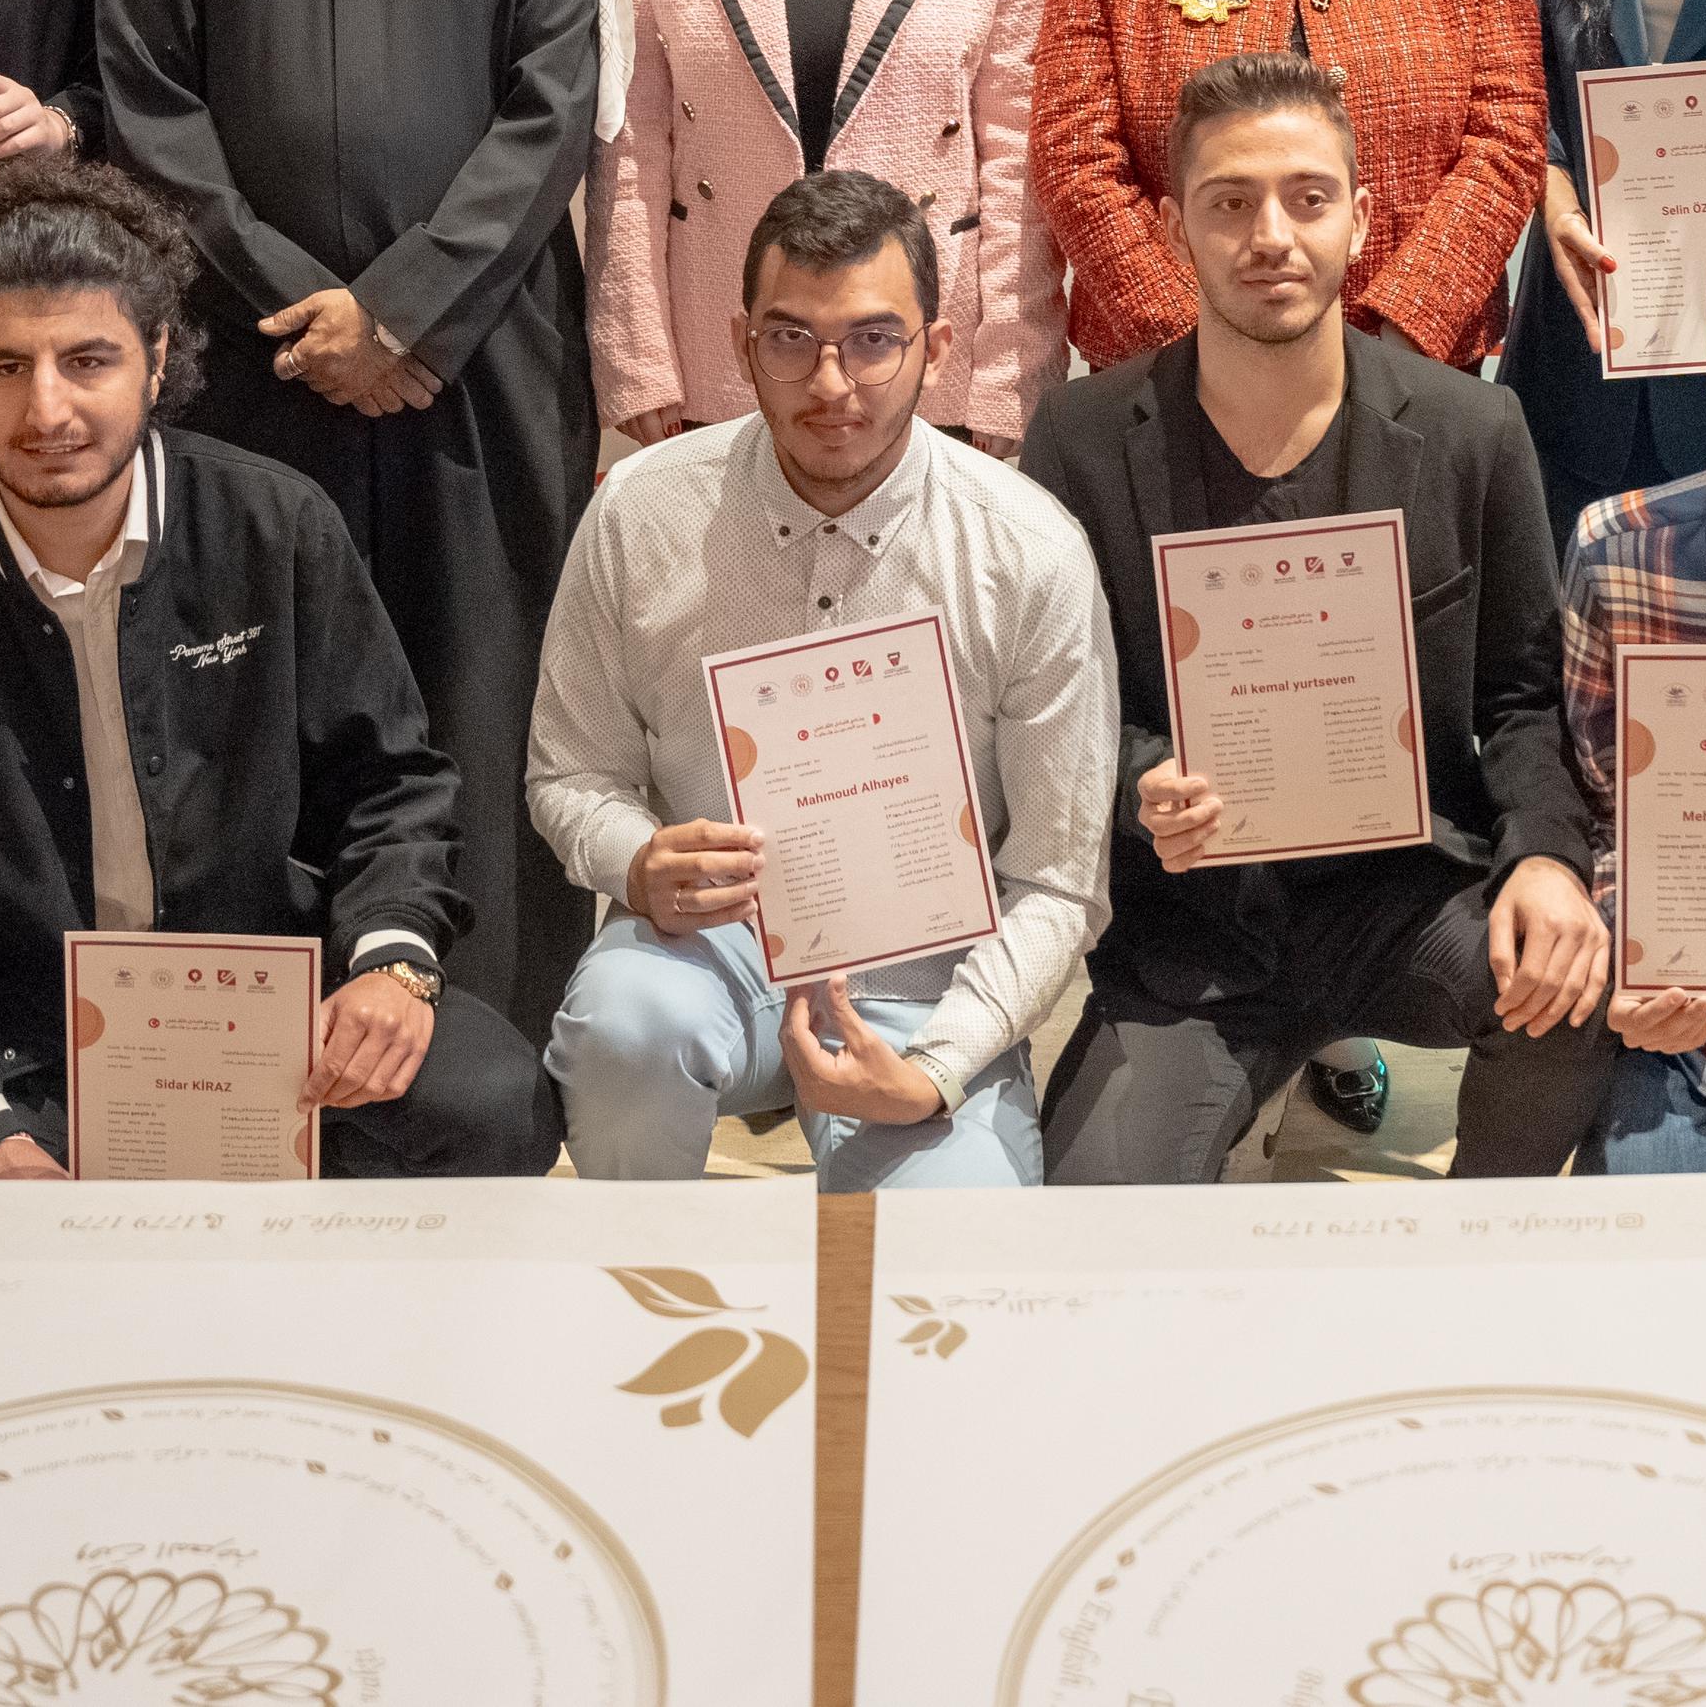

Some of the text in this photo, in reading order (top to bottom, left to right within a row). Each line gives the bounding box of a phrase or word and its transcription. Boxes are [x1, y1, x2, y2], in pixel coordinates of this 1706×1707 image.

[1661, 203, 1691, 217] Selin
[1229, 673, 1357, 698] Ali kemal yurtseven
[795, 772, 911, 810] Mahmoud Alhayes
[154, 1077, 233, 1093] Sidar KİRAZ
